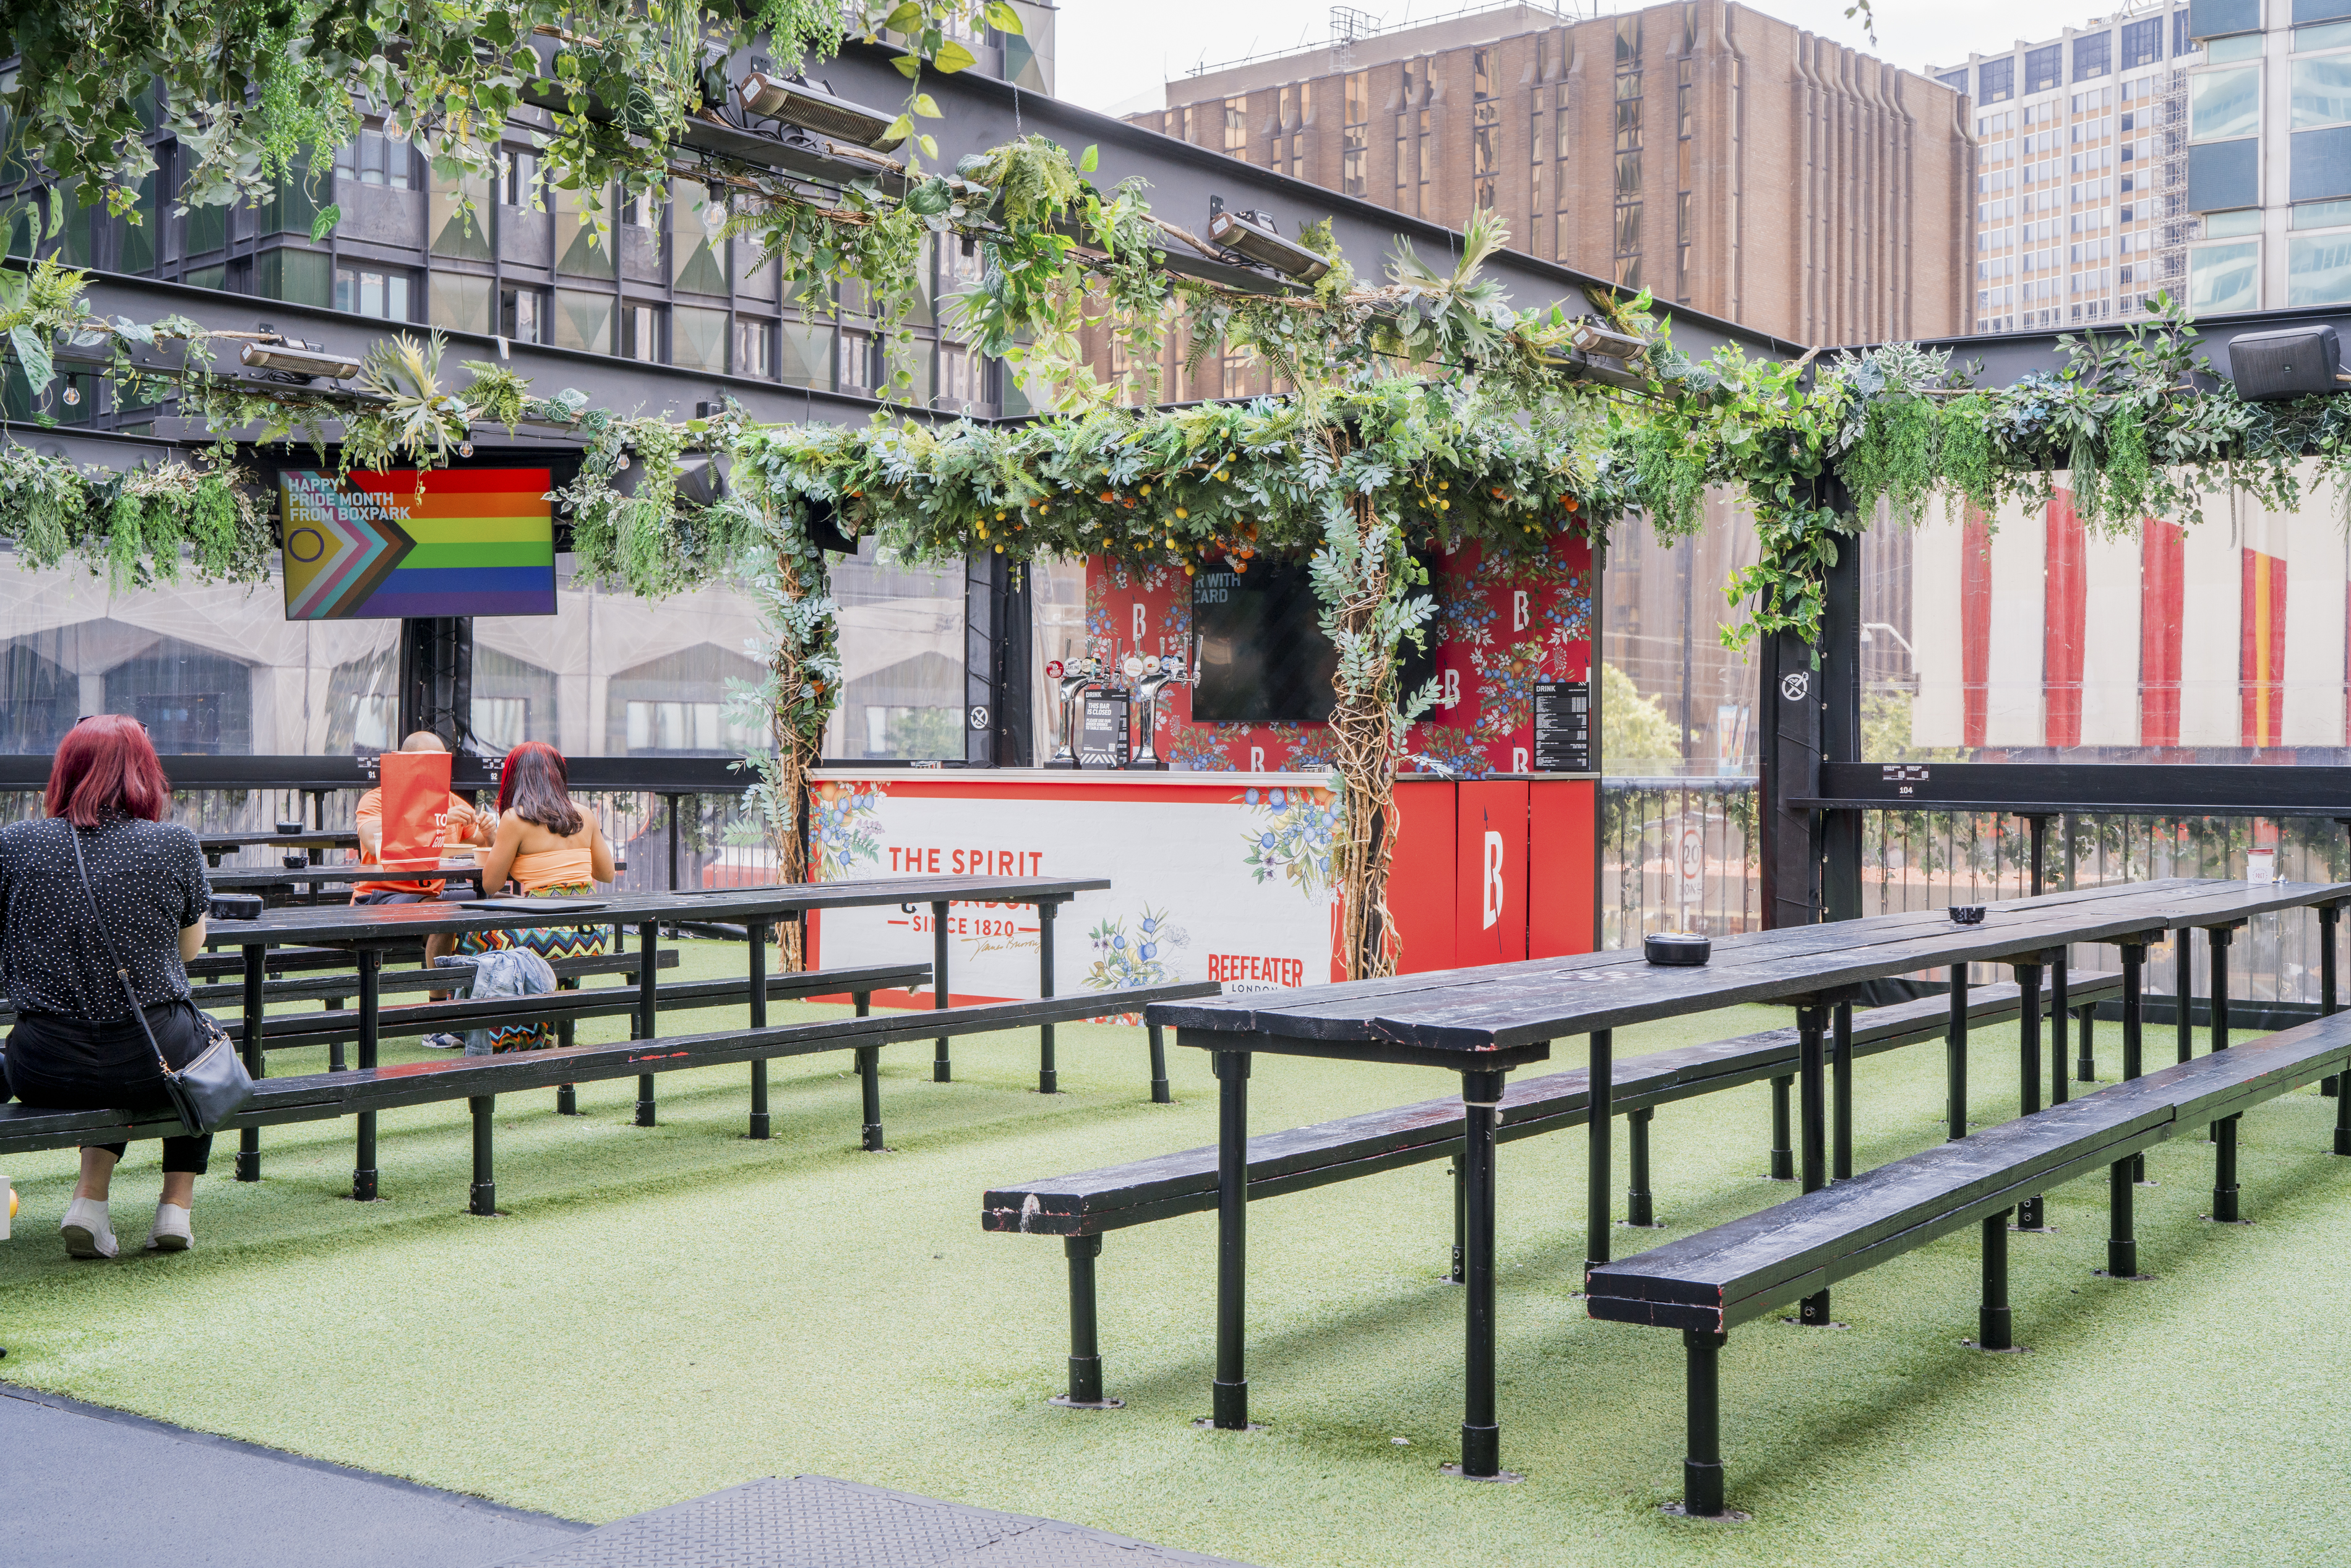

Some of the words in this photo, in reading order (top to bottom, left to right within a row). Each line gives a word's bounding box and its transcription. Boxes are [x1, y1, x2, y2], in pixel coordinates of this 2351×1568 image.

[288, 478, 340, 492] HAPPY
[289, 493, 335, 507] PRIDE
[340, 492, 393, 506] MONTH
[290, 508, 333, 521] FROM
[338, 507, 411, 521] BOXPARK
[1207, 573, 1240, 587] WITH
[1193, 589, 1228, 604] CARD
[889, 847, 940, 873] THE
[952, 849, 1042, 876] SPIRIT
[1683, 844, 1700, 863] 20
[1483, 831, 1503, 930] B
[974, 919, 1014, 936] 1820
[1208, 954, 1303, 988] BEEFEATER
